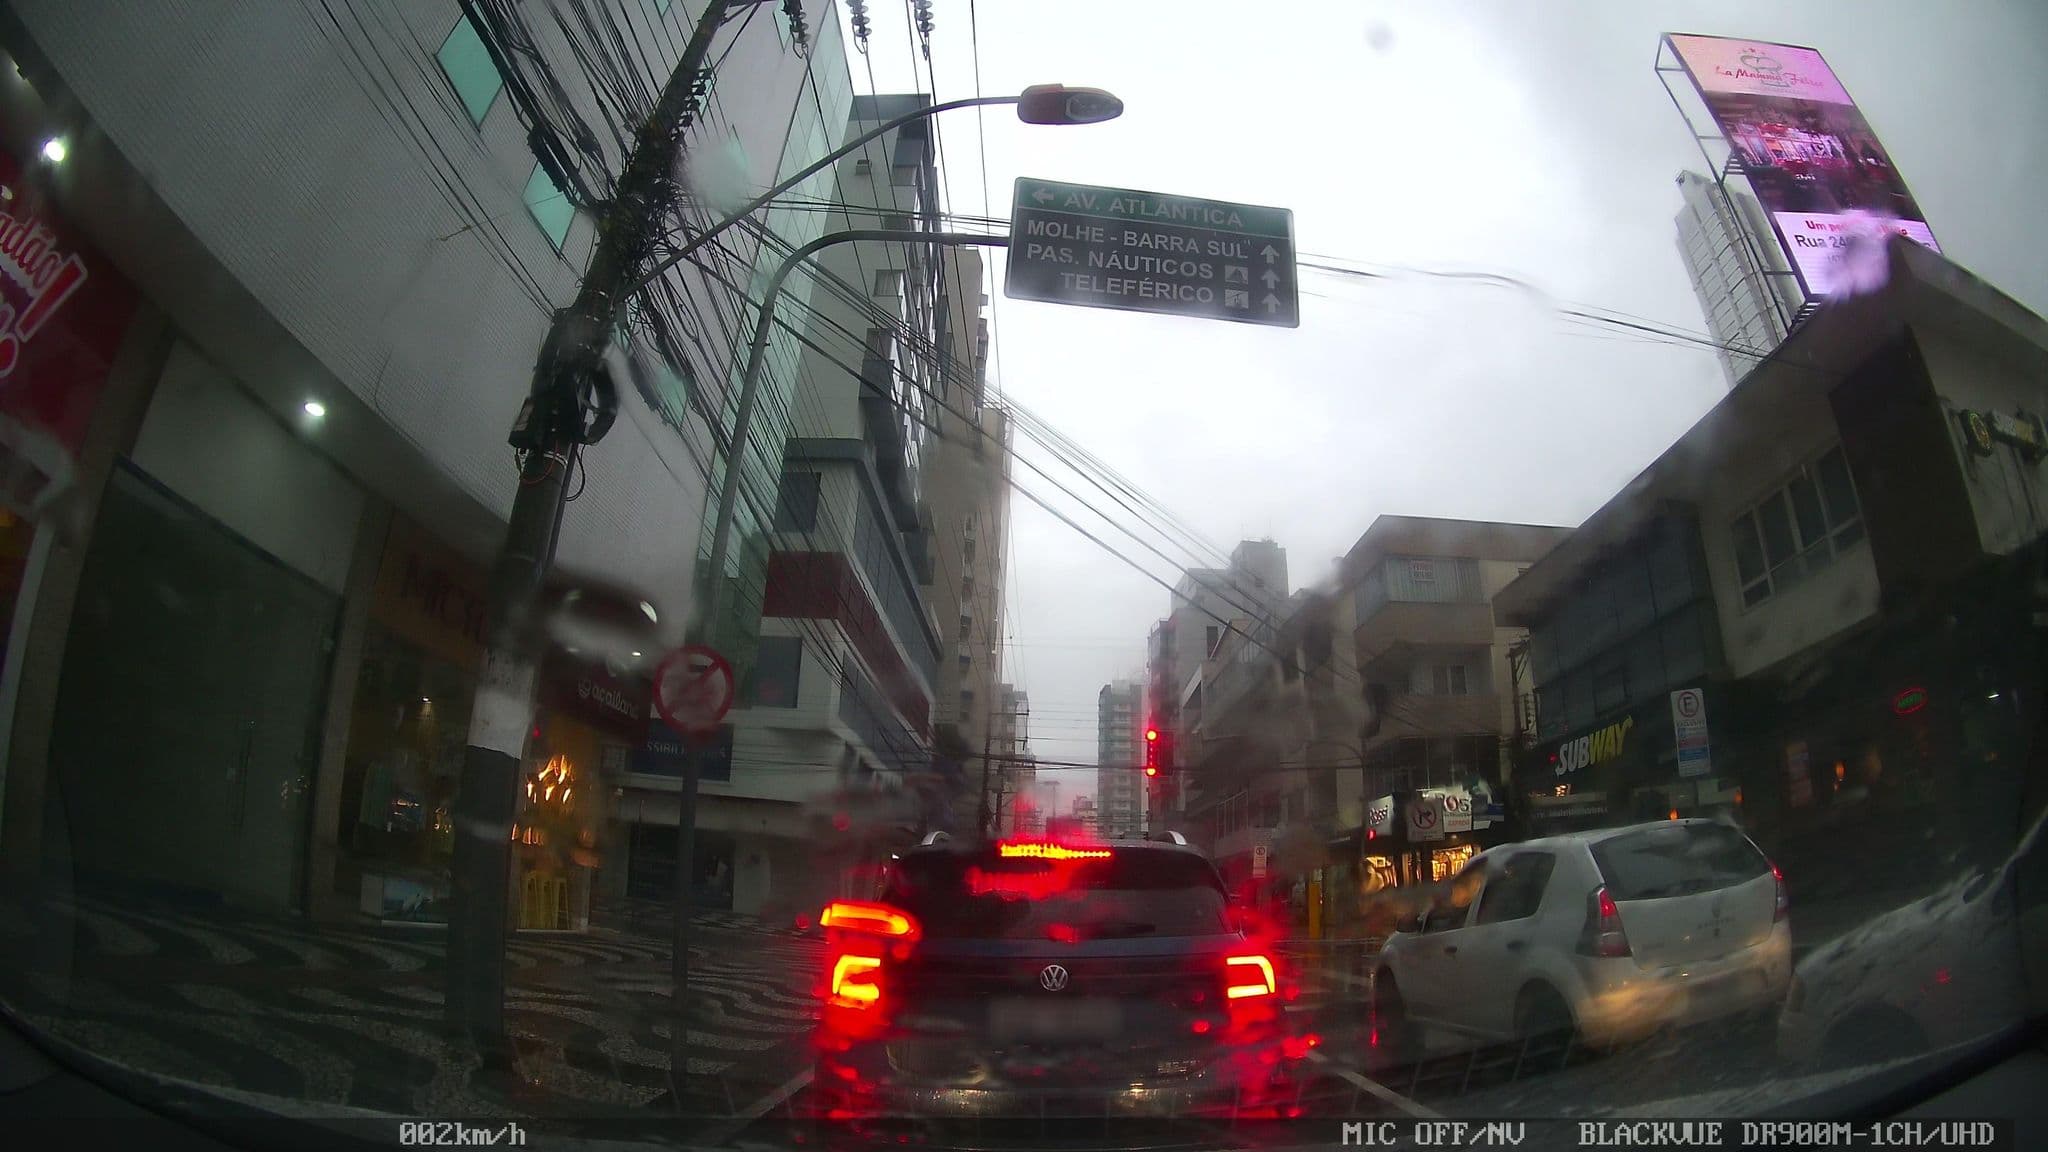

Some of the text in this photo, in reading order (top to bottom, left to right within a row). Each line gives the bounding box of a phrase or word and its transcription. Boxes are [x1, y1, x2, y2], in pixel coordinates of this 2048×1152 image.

[1064, 191, 1244, 228] AV. ATLÂNTICA
[1805, 220, 1827, 230] Um
[1026, 218, 1105, 243] MOLHE
[1123, 230, 1200, 255] BARRA
[1207, 239, 1250, 260] SUL
[1793, 234, 1827, 248] Rua
[1026, 243, 1215, 280] PAS. NÁUTICOS
[1060, 272, 1215, 304] TELEFÉRICO
[1555, 715, 1633, 779] SUBWAY
